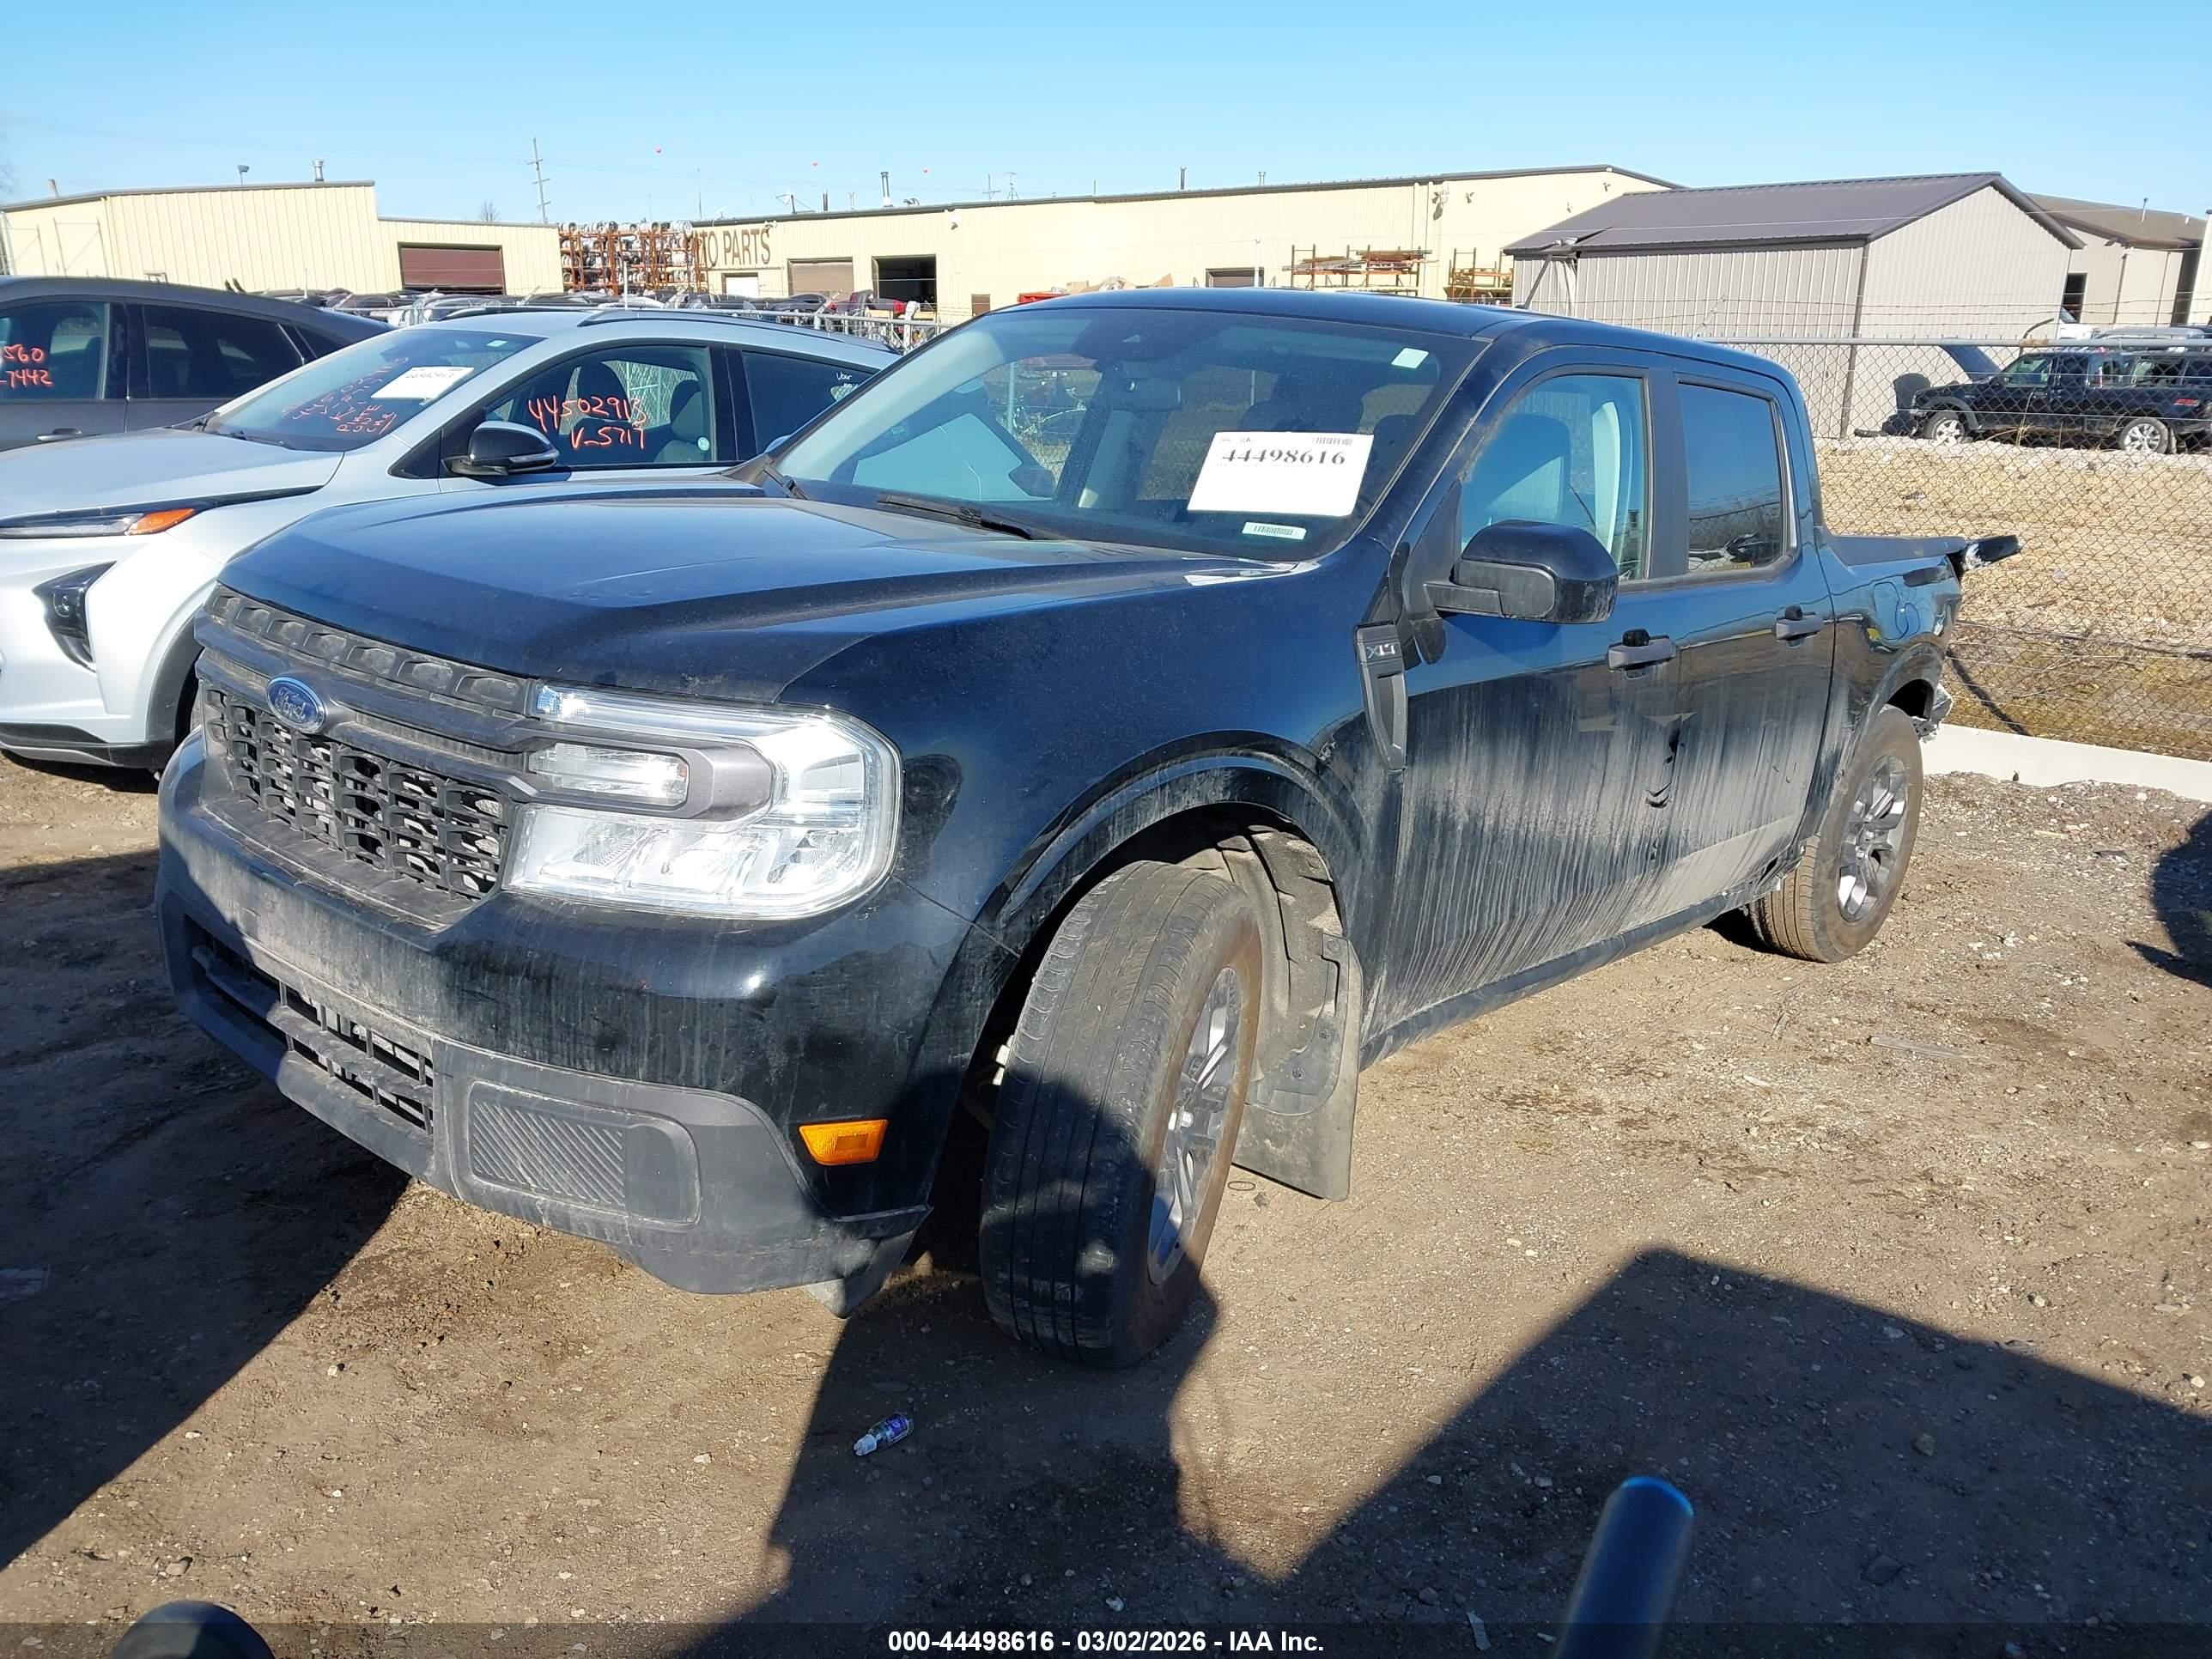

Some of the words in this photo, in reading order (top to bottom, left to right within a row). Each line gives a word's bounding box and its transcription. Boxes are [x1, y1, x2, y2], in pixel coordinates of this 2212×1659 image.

[723, 228, 771, 266] PARTS
[1222, 448, 1346, 465] 44498616
[1365, 641, 1401, 659] XLT
[274, 686, 307, 721] Ford
